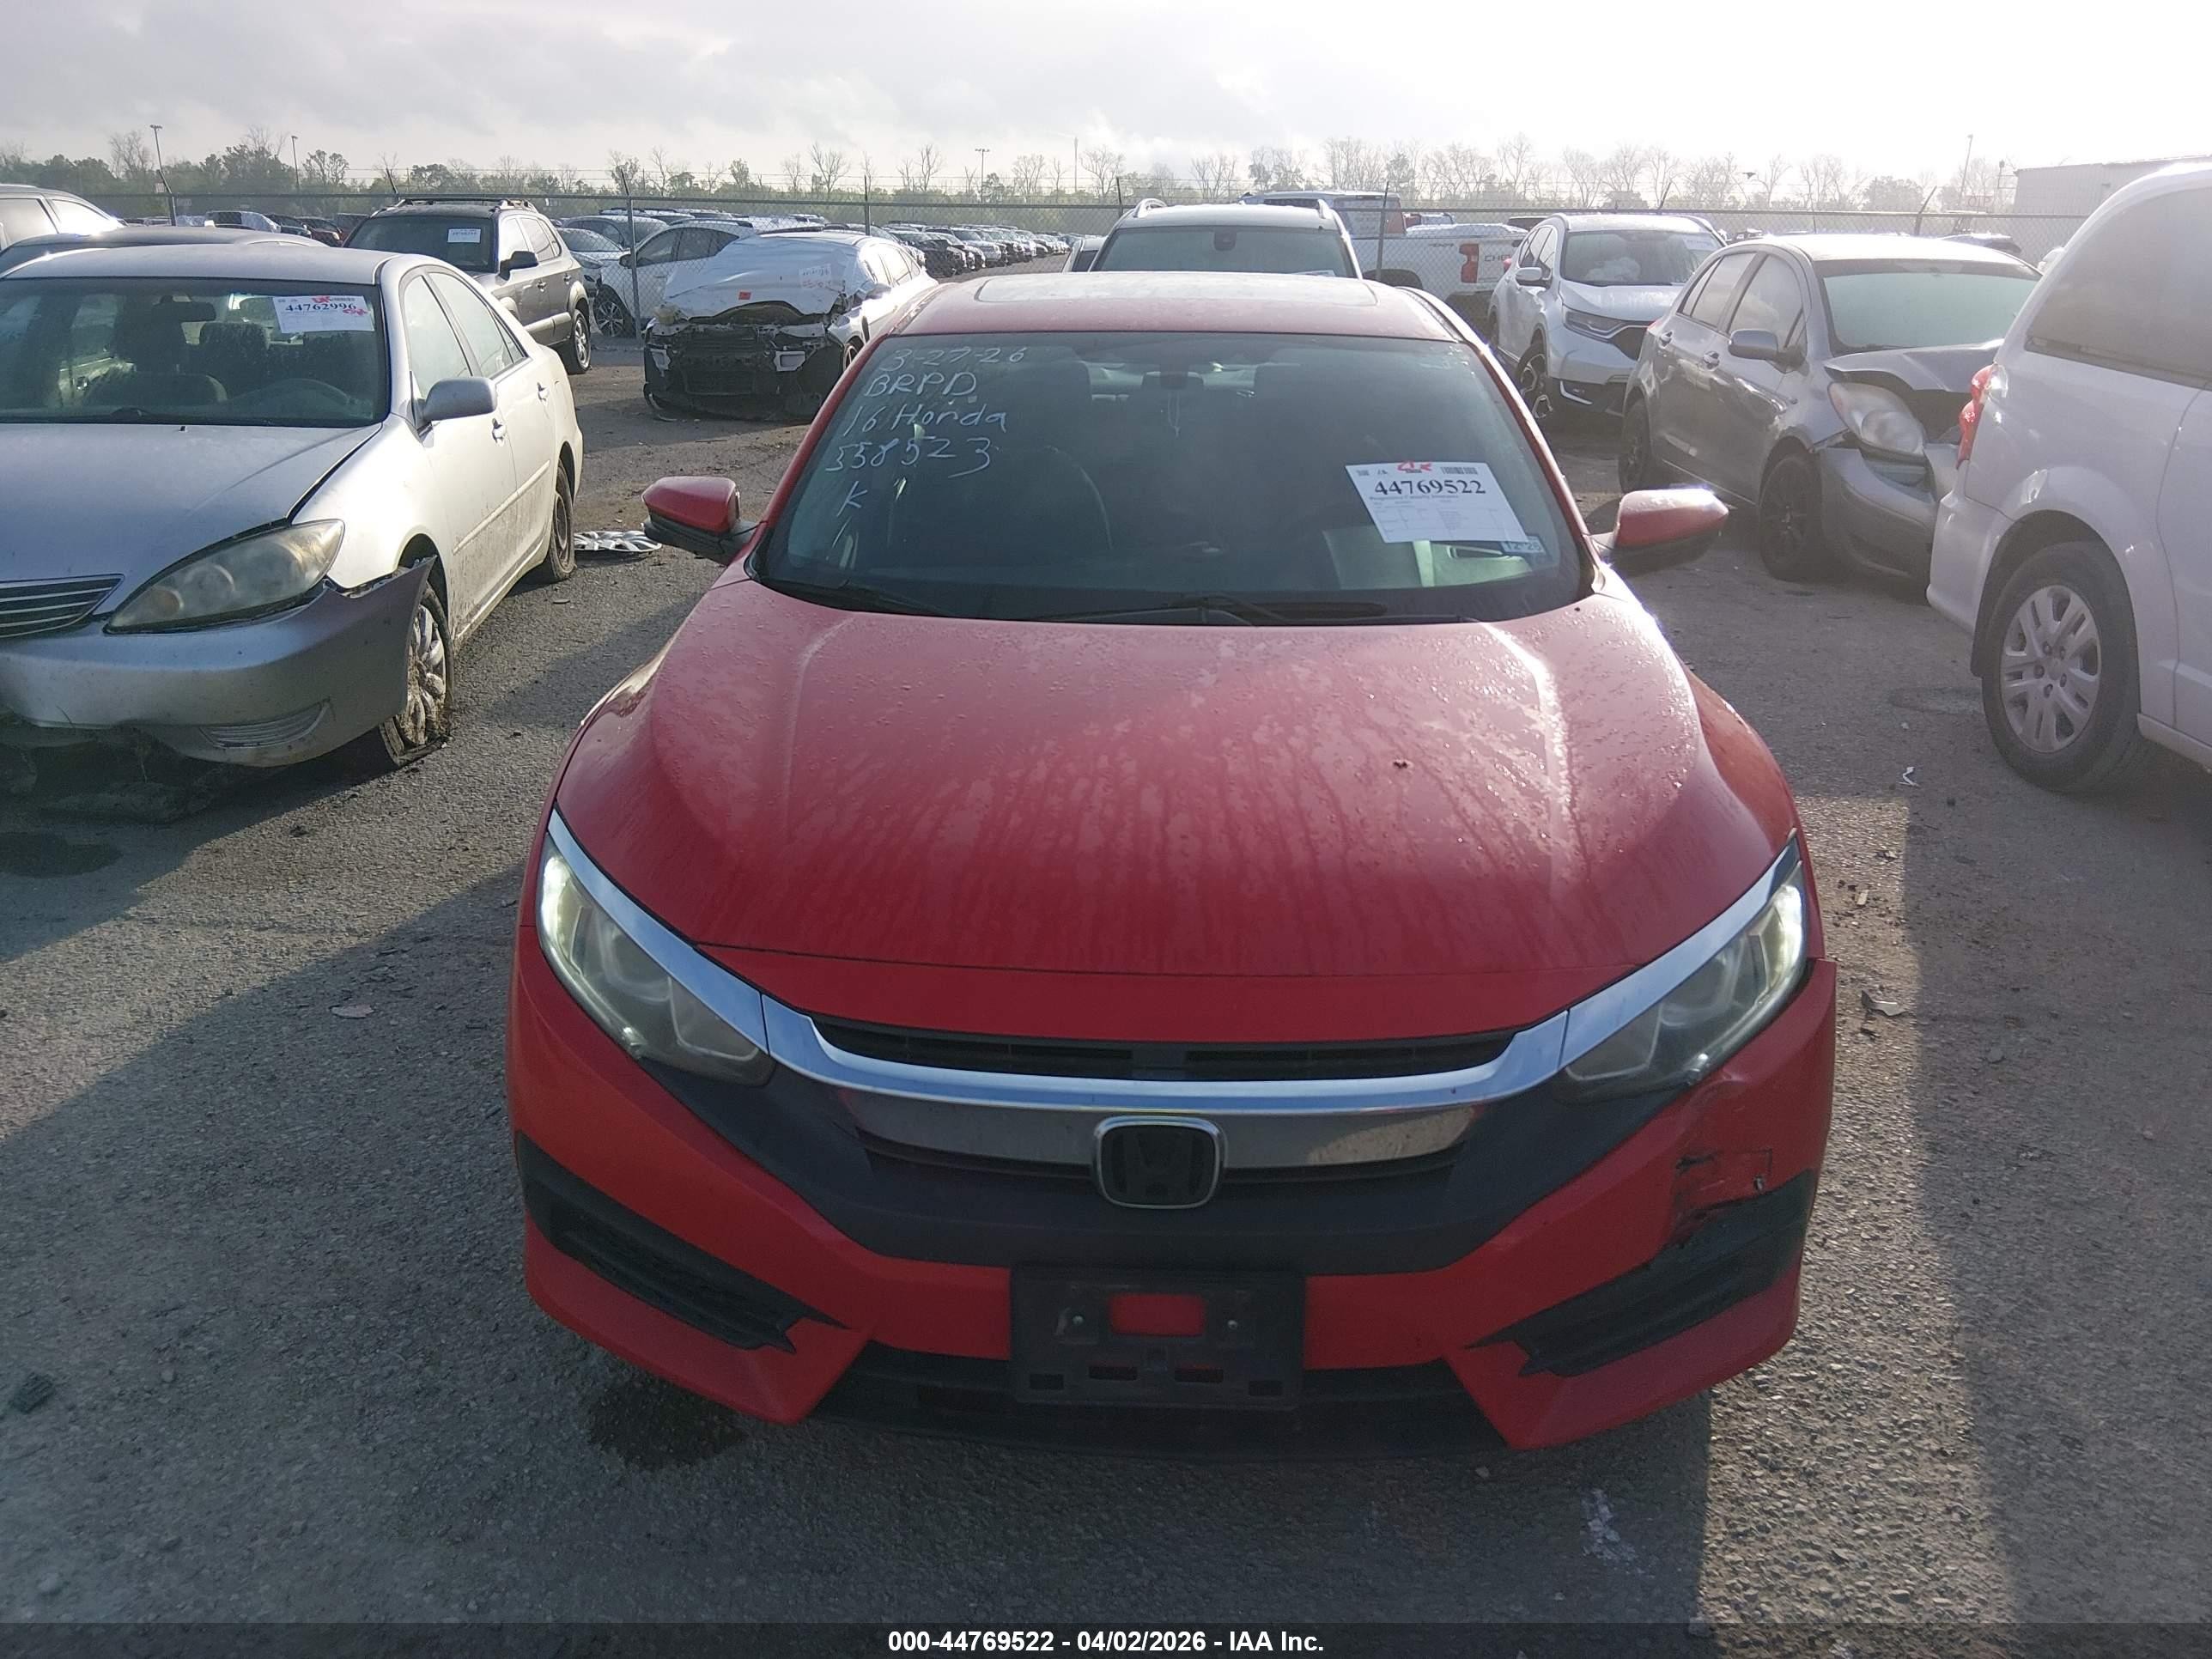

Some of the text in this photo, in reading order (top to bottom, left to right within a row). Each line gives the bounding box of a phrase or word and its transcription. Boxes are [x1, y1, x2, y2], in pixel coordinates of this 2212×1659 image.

[285, 303, 357, 312] 44762996
[878, 346, 1029, 372] 3-27-26
[863, 372, 977, 398] BRPD
[843, 404, 1007, 436] 16 Honda
[836, 480, 868, 517] K
[1374, 479, 1486, 495] 44769522
